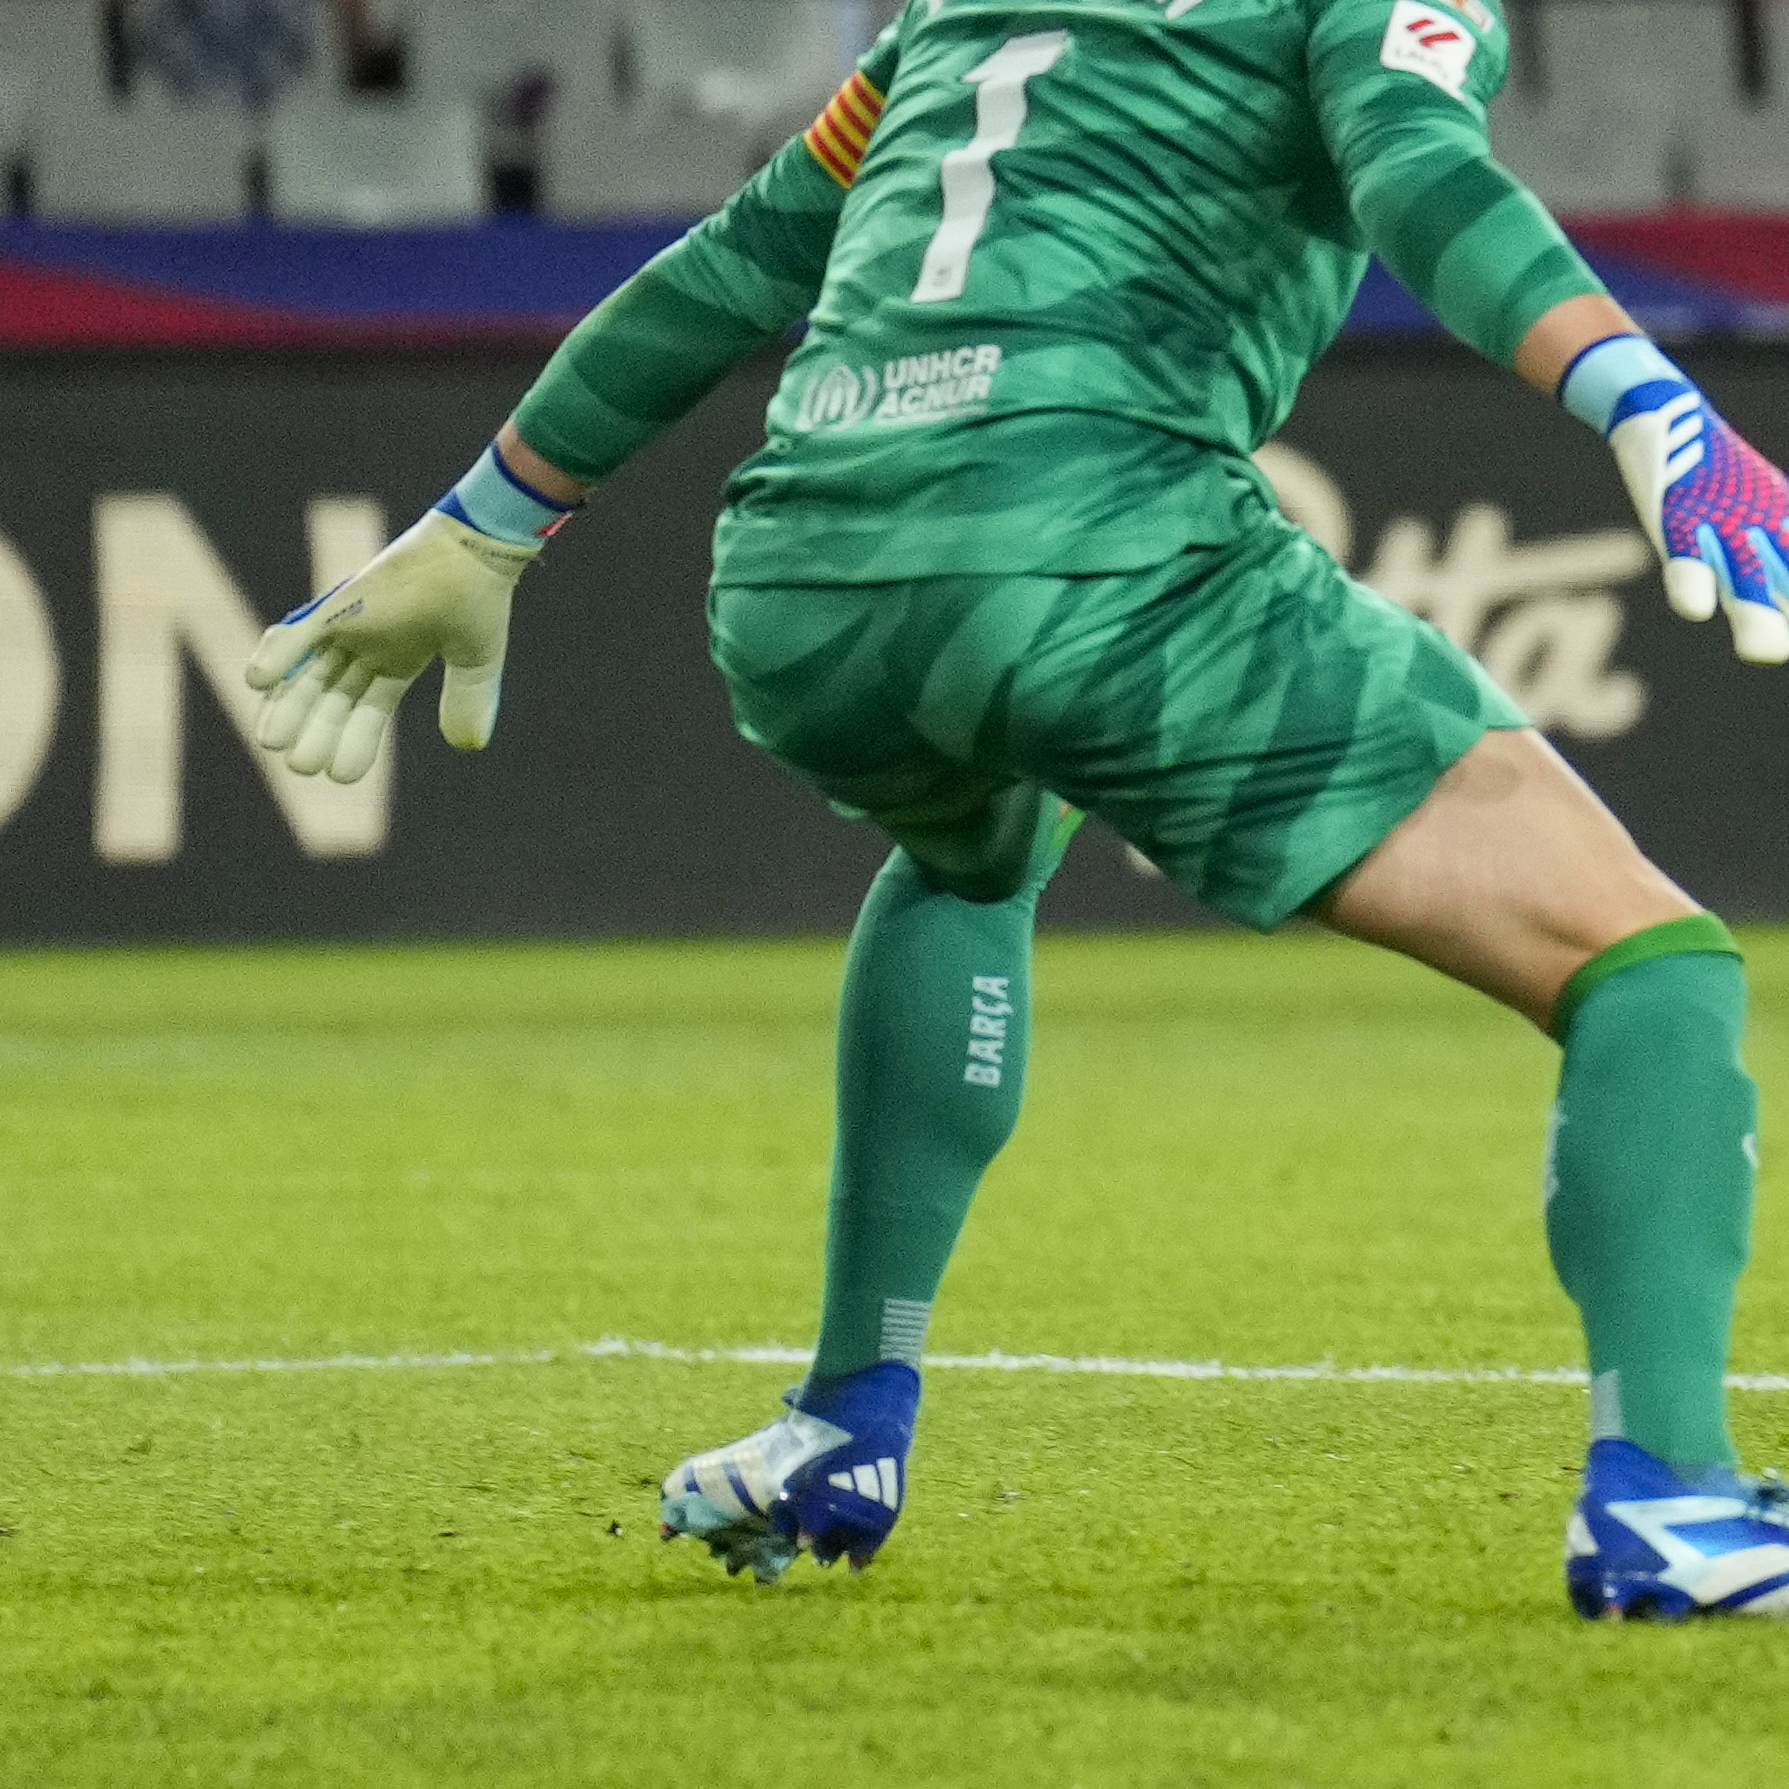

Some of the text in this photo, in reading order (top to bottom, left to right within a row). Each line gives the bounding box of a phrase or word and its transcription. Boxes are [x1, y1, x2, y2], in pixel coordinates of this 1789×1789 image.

[911, 28, 1069, 304] 1
[874, 374, 994, 424] ACNUR
[883, 343, 1002, 390] UNHCR
[963, 975, 1015, 1089] BARÇA
